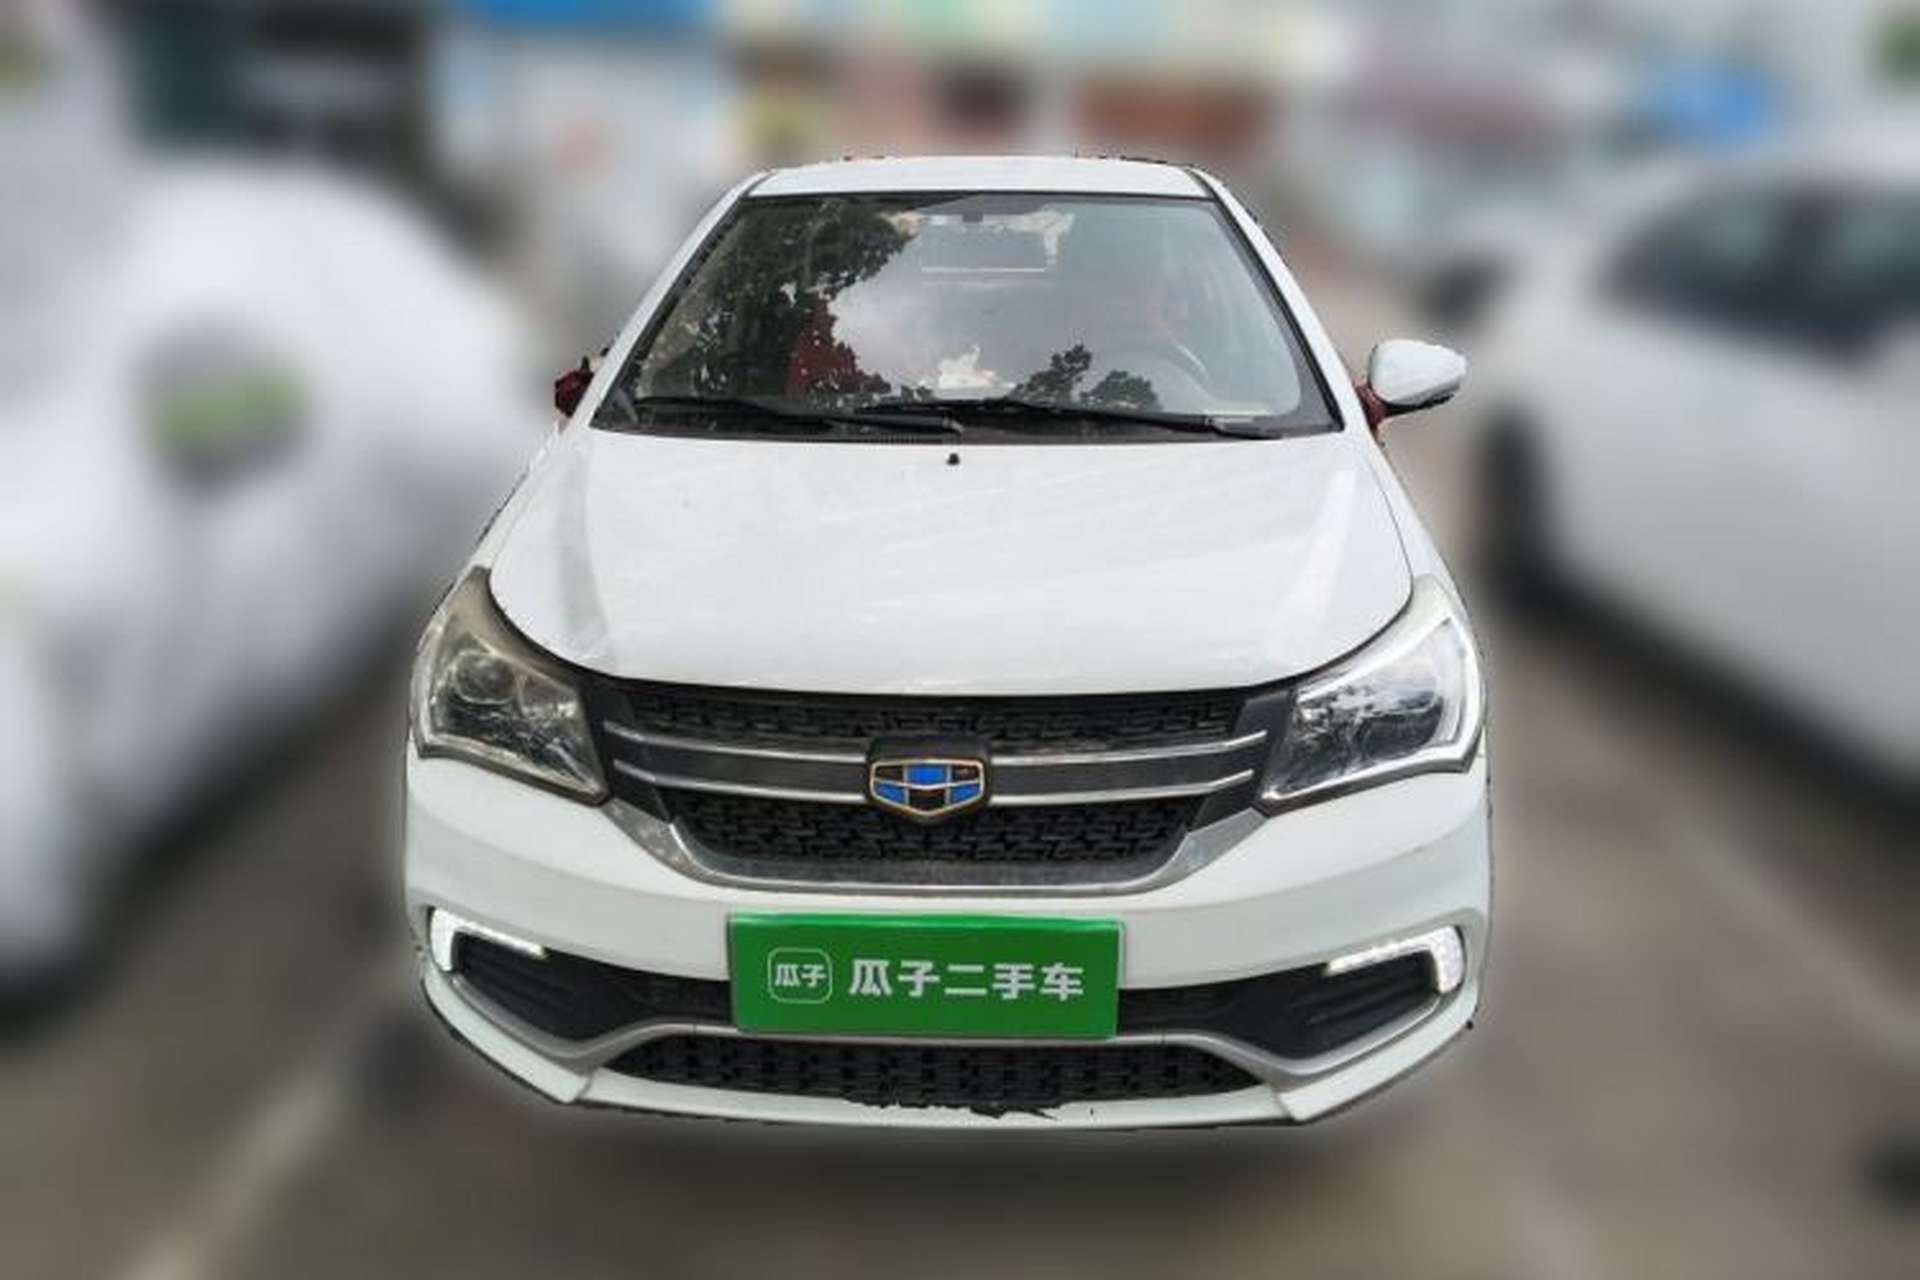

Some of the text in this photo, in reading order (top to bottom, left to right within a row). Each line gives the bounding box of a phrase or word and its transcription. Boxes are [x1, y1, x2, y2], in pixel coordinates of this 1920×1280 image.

[774, 963, 827, 988] 瓜子
[849, 959, 1084, 1001] 瓜子二手车
